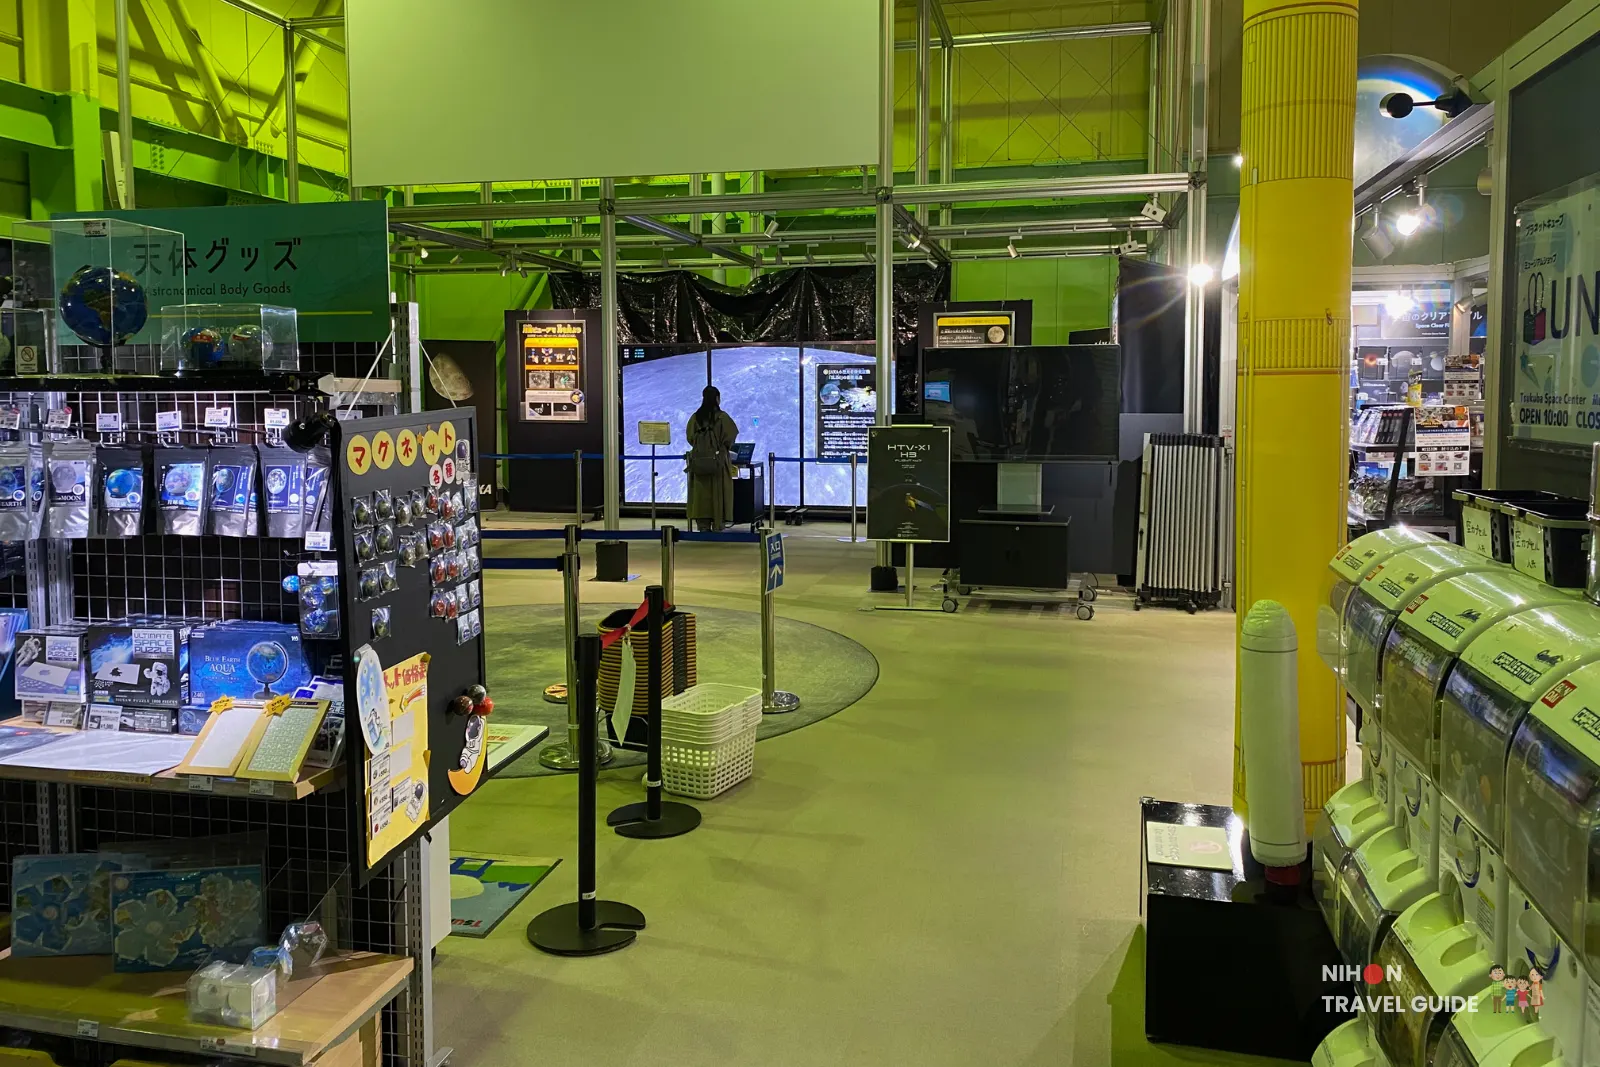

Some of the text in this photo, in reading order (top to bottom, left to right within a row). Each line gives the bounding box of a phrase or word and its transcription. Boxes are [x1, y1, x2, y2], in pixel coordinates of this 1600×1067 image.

[133, 237, 301, 277] 天体グッズ
[145, 281, 291, 297] stronomical Body Goods
[1520, 393, 1543, 404] Tsukuba
[1545, 393, 1562, 406] Space
[1564, 393, 1587, 405] Center
[1520, 408, 1541, 424] OPEN
[1544, 409, 1569, 427] 10:00
[353, 430, 453, 468] マグネット
[209, 664, 236, 675] AQUA
